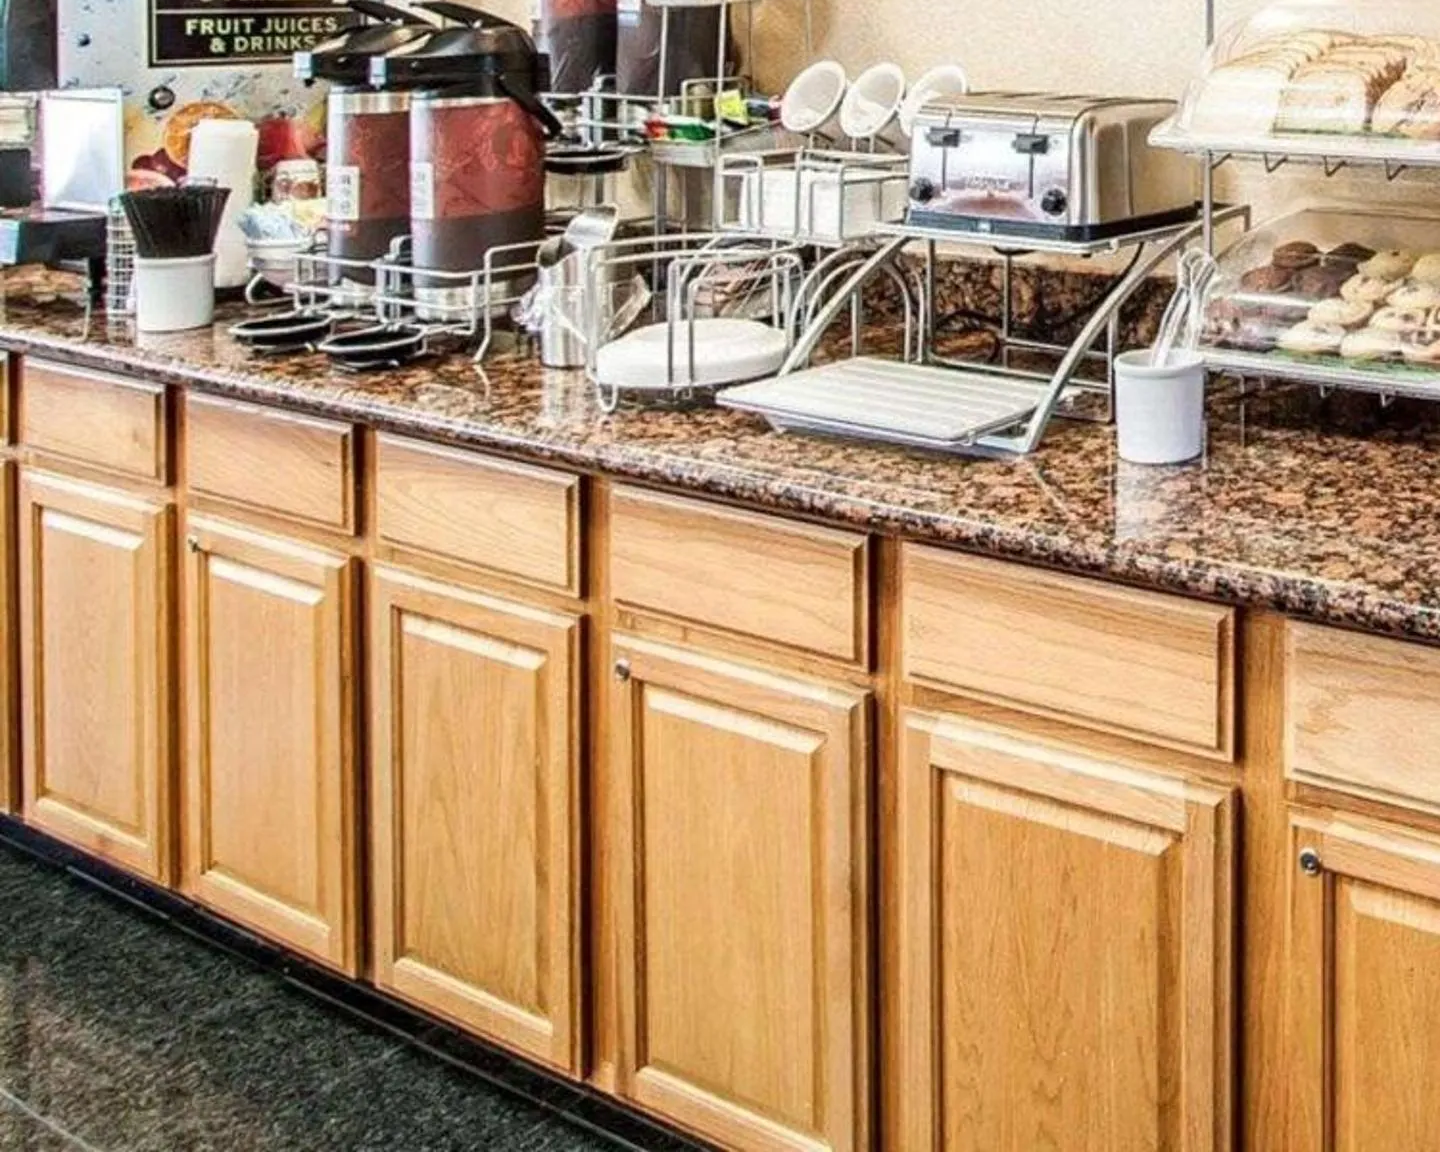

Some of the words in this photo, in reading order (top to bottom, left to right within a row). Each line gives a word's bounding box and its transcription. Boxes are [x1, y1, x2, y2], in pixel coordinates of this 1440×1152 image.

[184, 18, 257, 36] FRUIT
[262, 16, 339, 35] JUICES
[209, 37, 226, 54] &
[233, 35, 318, 53] DRINKS
